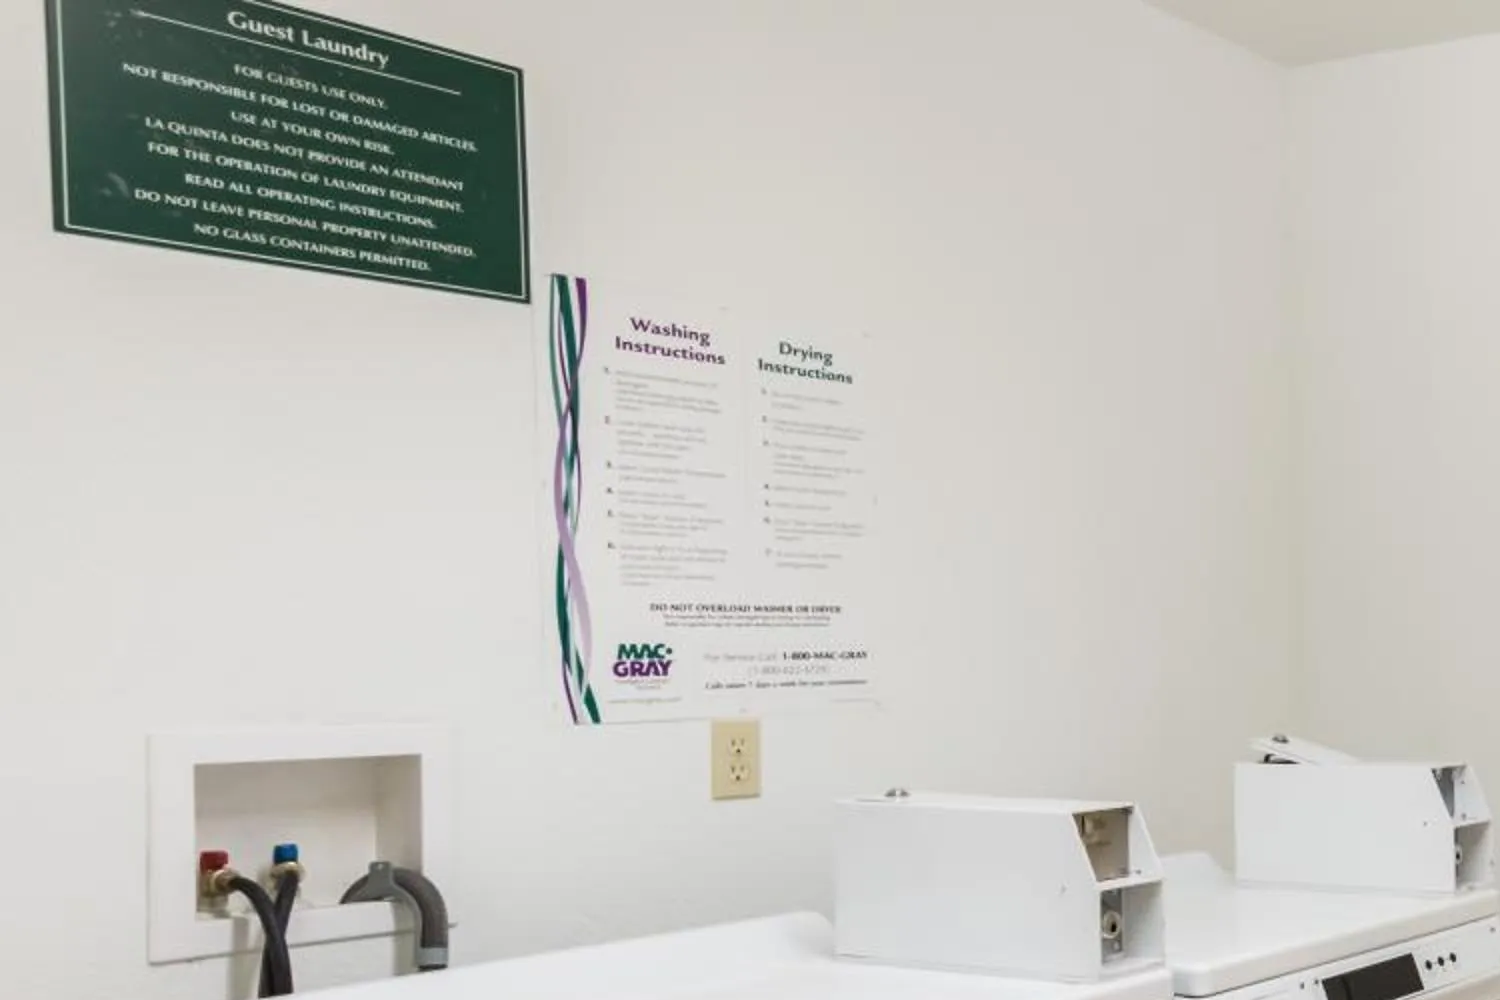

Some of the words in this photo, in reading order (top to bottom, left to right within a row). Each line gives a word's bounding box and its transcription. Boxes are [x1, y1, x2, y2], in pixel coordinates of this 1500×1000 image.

[227, 10, 294, 42] Guest
[302, 29, 389, 70] Laundry
[123, 61, 157, 79] NOT
[161, 71, 256, 102] RESPONSIBLE
[260, 93, 289, 109] FOR
[292, 101, 326, 117] LOST
[329, 109, 350, 123] OR
[352, 115, 419, 138] DAMAGED
[421, 130, 479, 152] ARTICLES.
[234, 63, 263, 81] FOR
[267, 71, 319, 93] GUESTS
[322, 86, 347, 100] USE
[350, 91, 388, 110] ONLY.
[145, 116, 165, 131] LA
[167, 121, 228, 143] QUINTA
[231, 134, 271, 151] DOES
[273, 143, 304, 158] NOT
[307, 150, 367, 171] PROVIDE
[370, 164, 389, 176] AN
[392, 168, 464, 192] ATTENDANT
[230, 111, 257, 126] USE
[261, 117, 278, 129] AT
[282, 121, 322, 140] YOUR
[325, 131, 361, 148] OWN
[364, 139, 395, 156] RISK.
[147, 141, 179, 157] FOR
[183, 148, 212, 164] THE
[215, 155, 299, 180] OPERATION
[301, 171, 320, 184] OF
[323, 176, 386, 198] LAUNDRY
[389, 189, 464, 213] EQUIPMENT.
[134, 188, 161, 203] DO
[164, 193, 198, 209] NOT
[202, 200, 245, 217] LEAVE
[248, 208, 319, 230] PERSONAL
[322, 221, 387, 242] PROPERTY
[390, 234, 477, 258] UNATTENDED.
[185, 173, 225, 190] READ
[228, 182, 253, 195] ALL
[256, 187, 336, 211] OPERATING
[339, 202, 437, 229] INSTRUCTIONS.
[193, 223, 219, 236] NO
[222, 227, 266, 244] GLASS
[269, 232, 357, 259] CONTAINERS
[359, 251, 432, 271] PERMITTED.
[615, 335, 726, 365] Instructions
[629, 317, 710, 347] Washing
[778, 341, 833, 366] Drying
[758, 358, 853, 385] Instructions
[612, 659, 672, 677] GRAY
